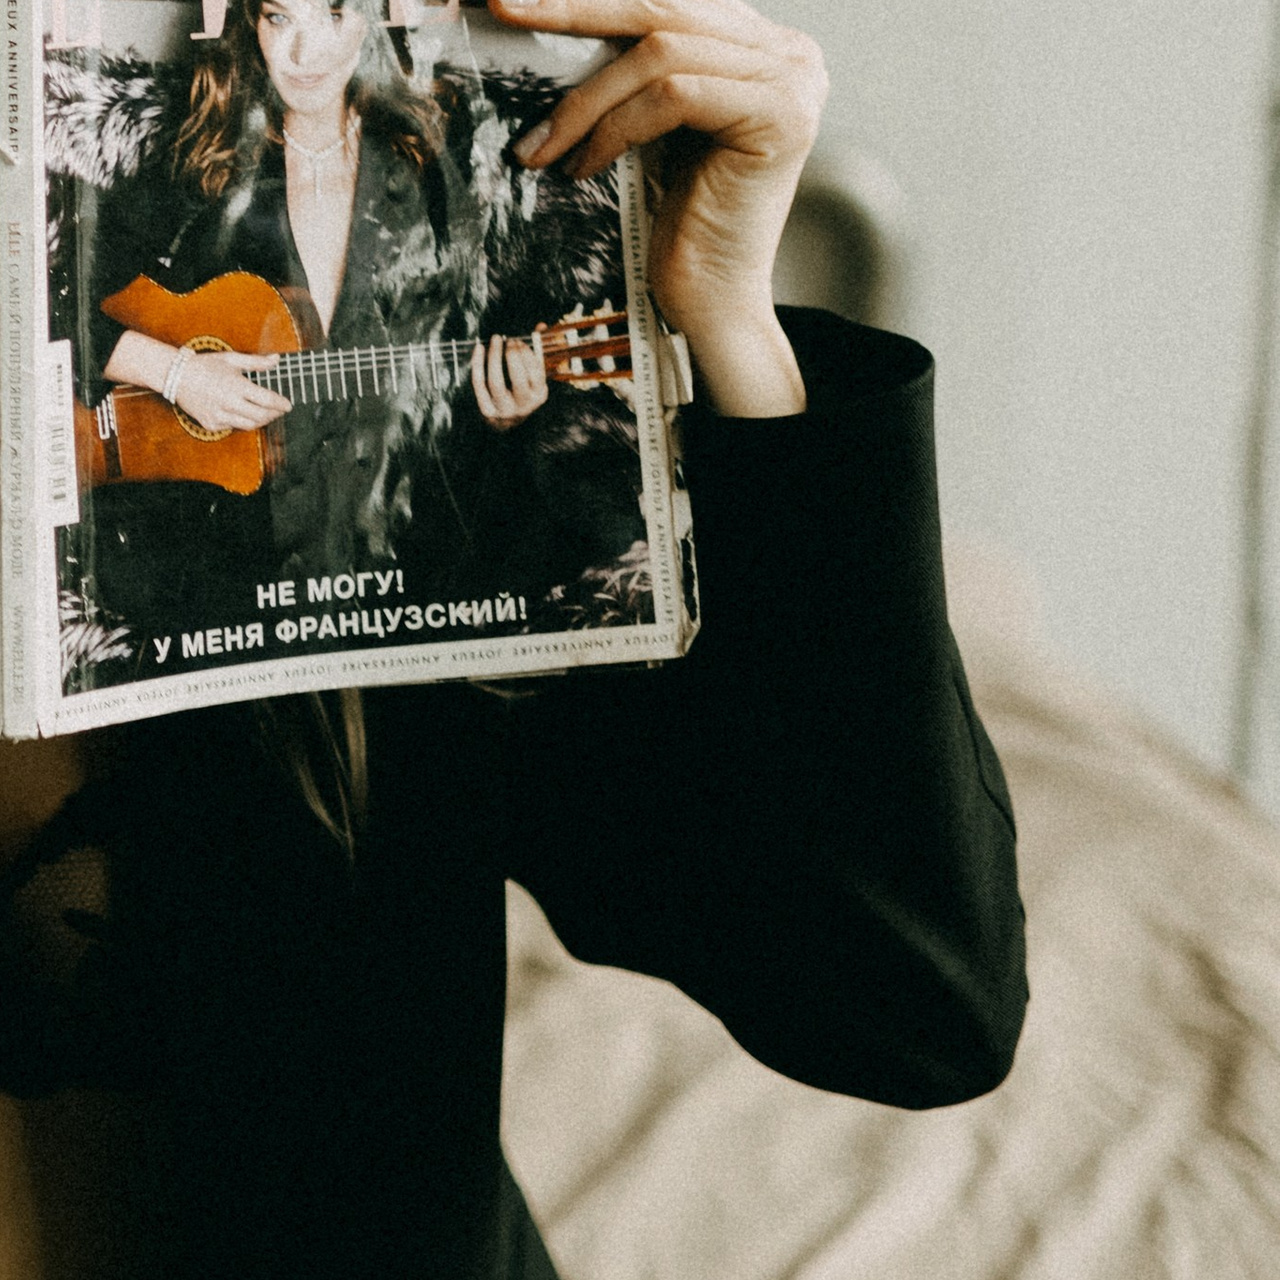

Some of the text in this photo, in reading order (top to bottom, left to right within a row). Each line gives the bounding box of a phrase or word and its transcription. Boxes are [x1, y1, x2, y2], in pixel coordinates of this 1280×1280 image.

[256, 568, 405, 610] НЕ МОГУ!
[153, 591, 528, 664] У МЕНЯ ФРАНЦУЗСКИЙ!
